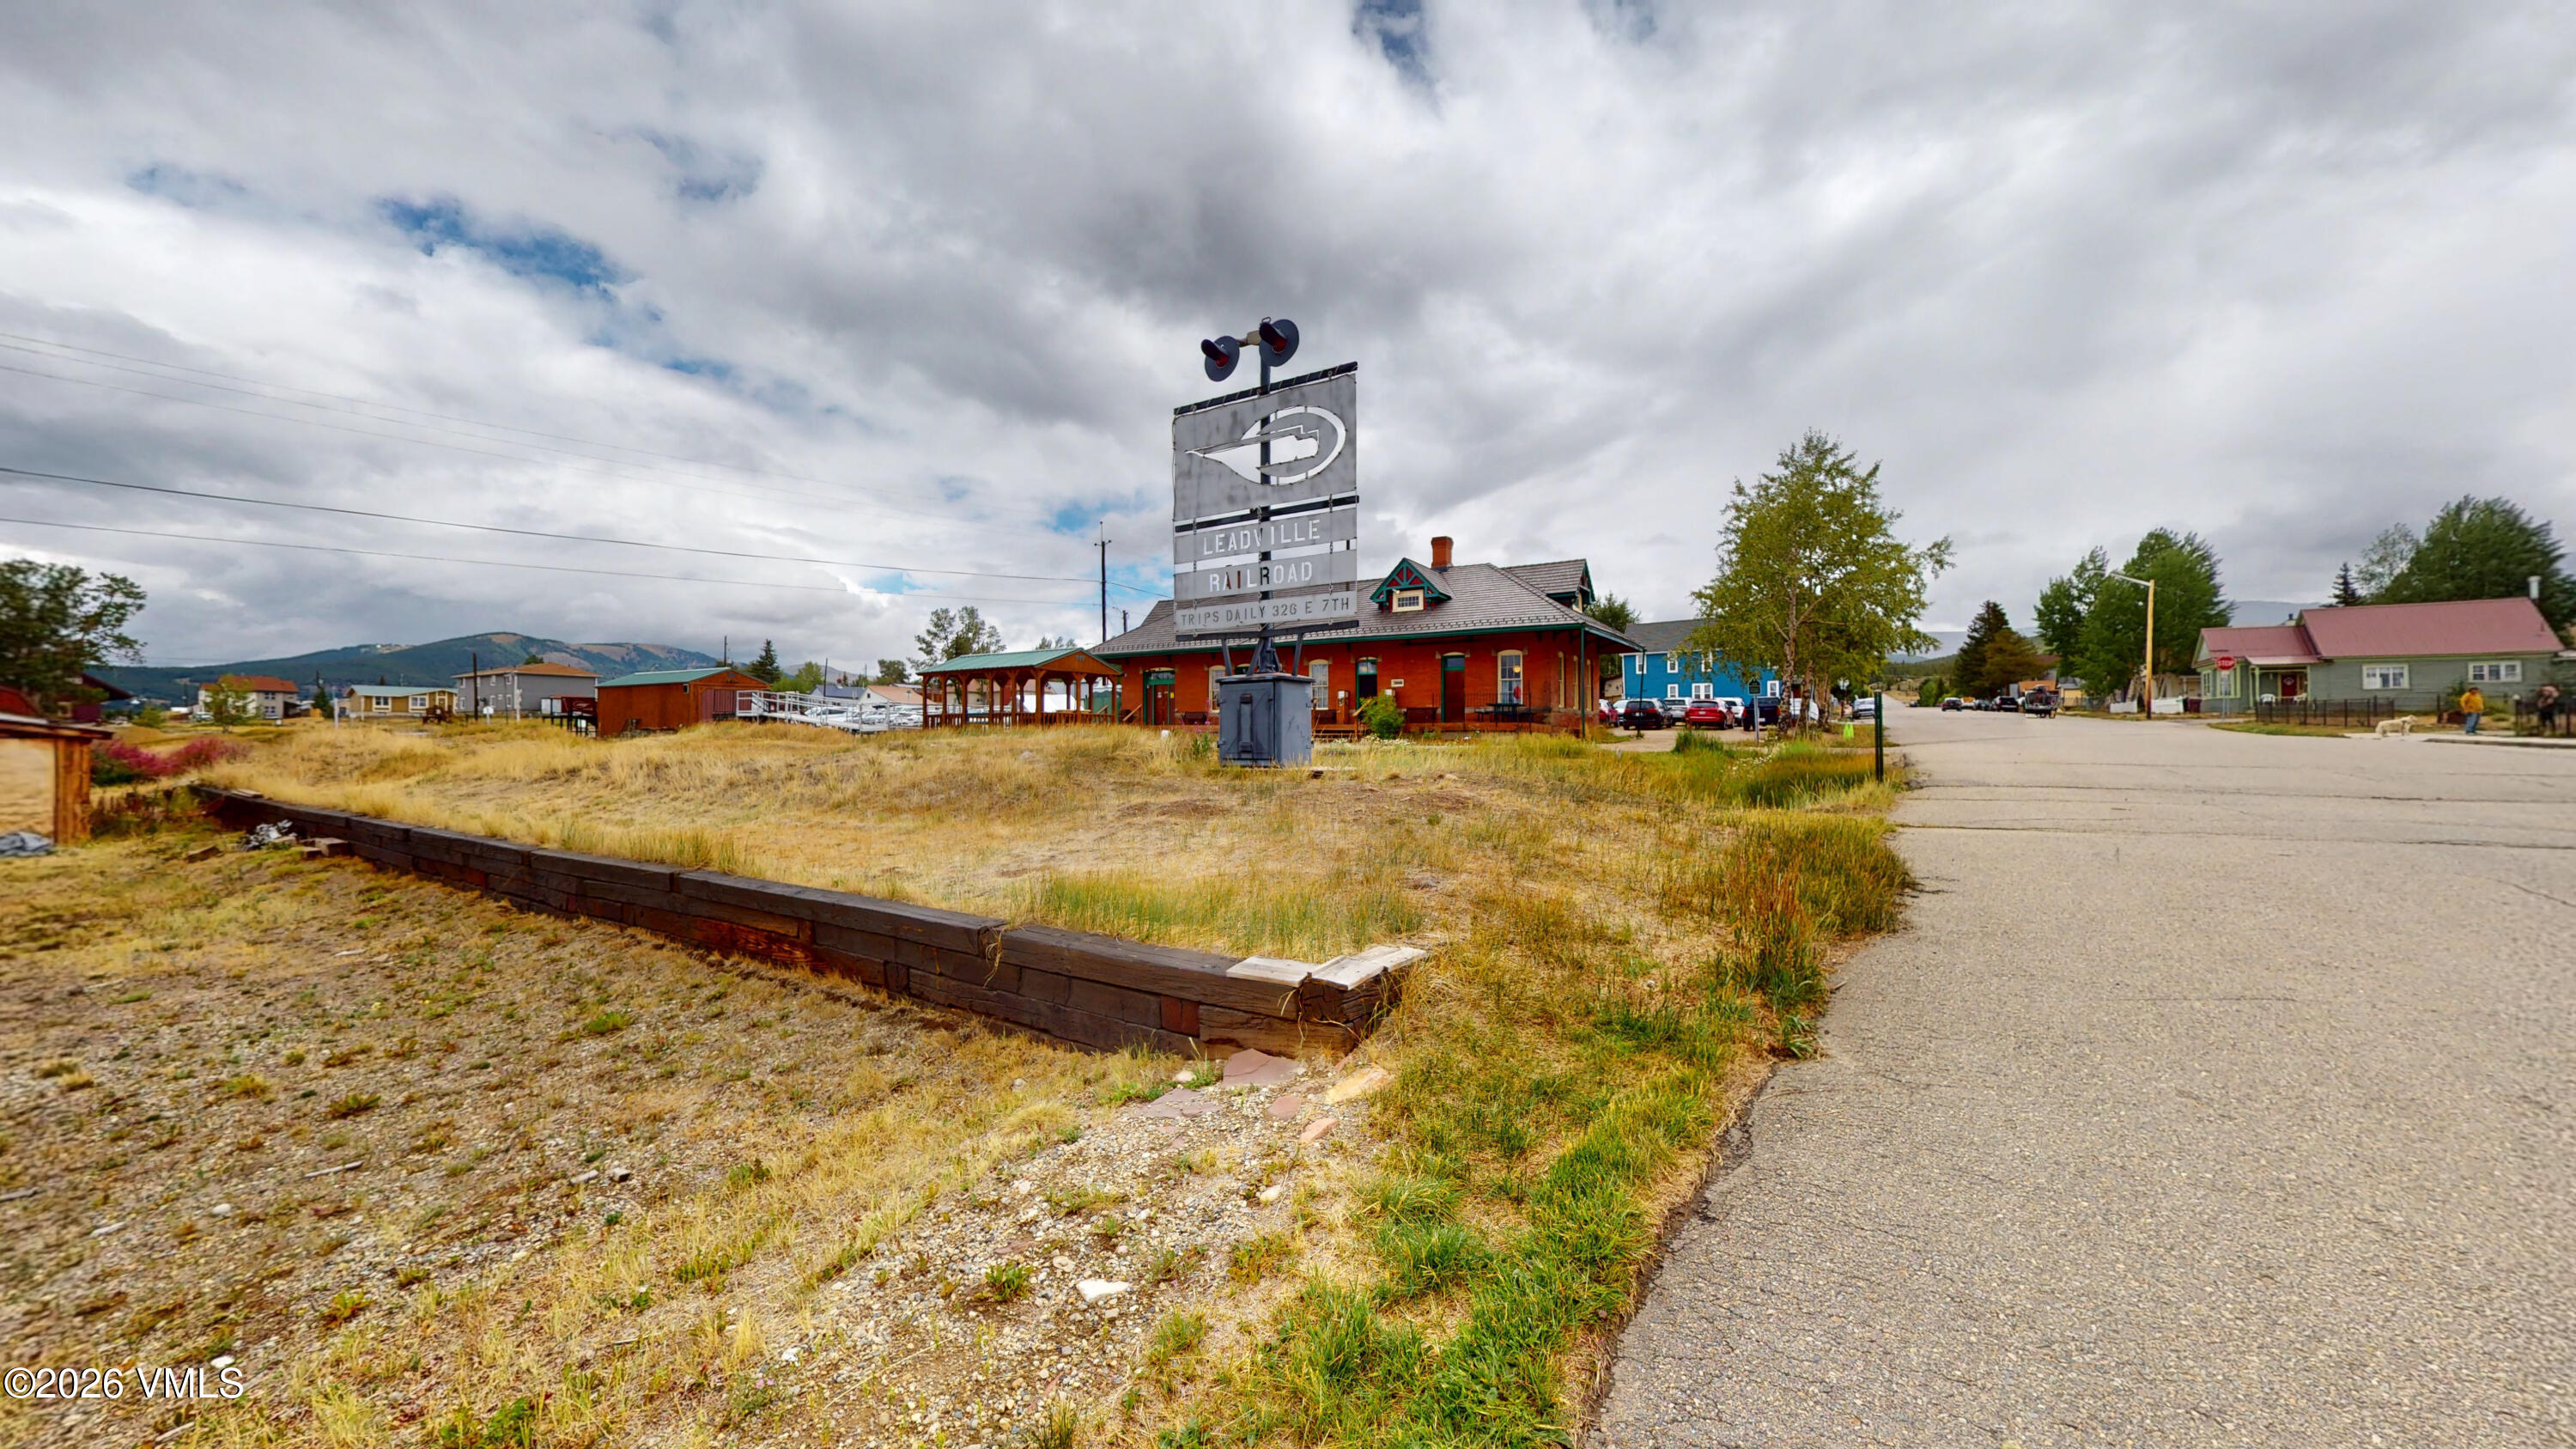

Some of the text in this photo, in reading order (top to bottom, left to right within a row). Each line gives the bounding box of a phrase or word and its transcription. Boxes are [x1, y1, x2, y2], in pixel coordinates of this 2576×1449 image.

[1203, 519, 1321, 556] LEADVILLE
[1209, 561, 1313, 593] RAILROAD
[1181, 611, 1219, 626] TRIPS
[1226, 606, 1265, 623] DAILY
[1305, 601, 1313, 614] E
[1322, 597, 1349, 612] 7TH
